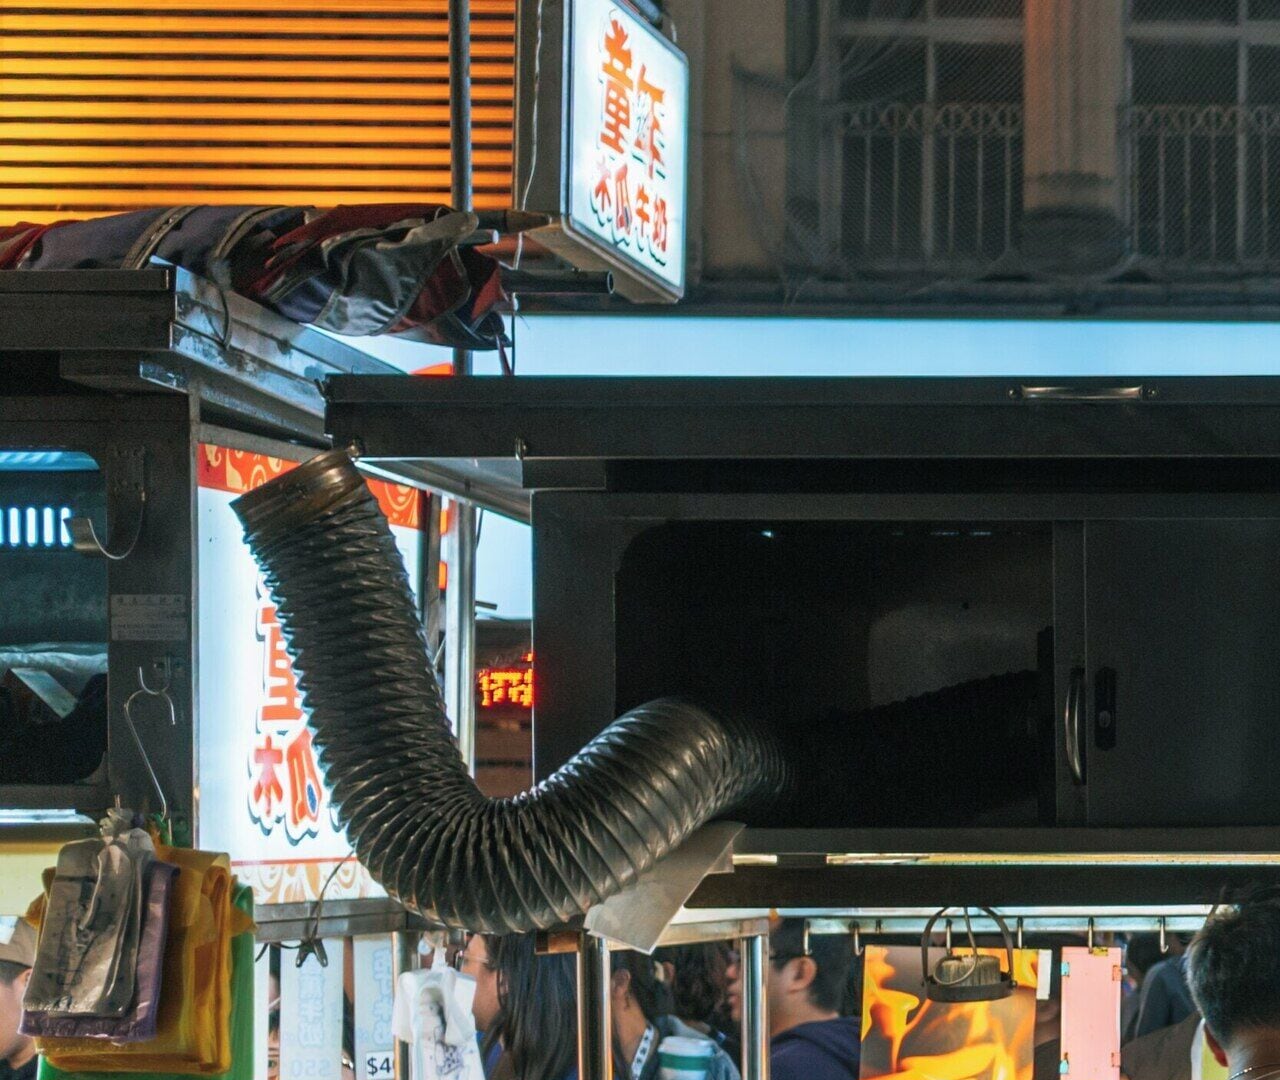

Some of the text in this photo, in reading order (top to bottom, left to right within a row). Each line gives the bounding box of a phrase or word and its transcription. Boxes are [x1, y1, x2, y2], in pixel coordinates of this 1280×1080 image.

[600, 18, 666, 180] 童年
[593, 155, 668, 253] 木瓜牛奶
